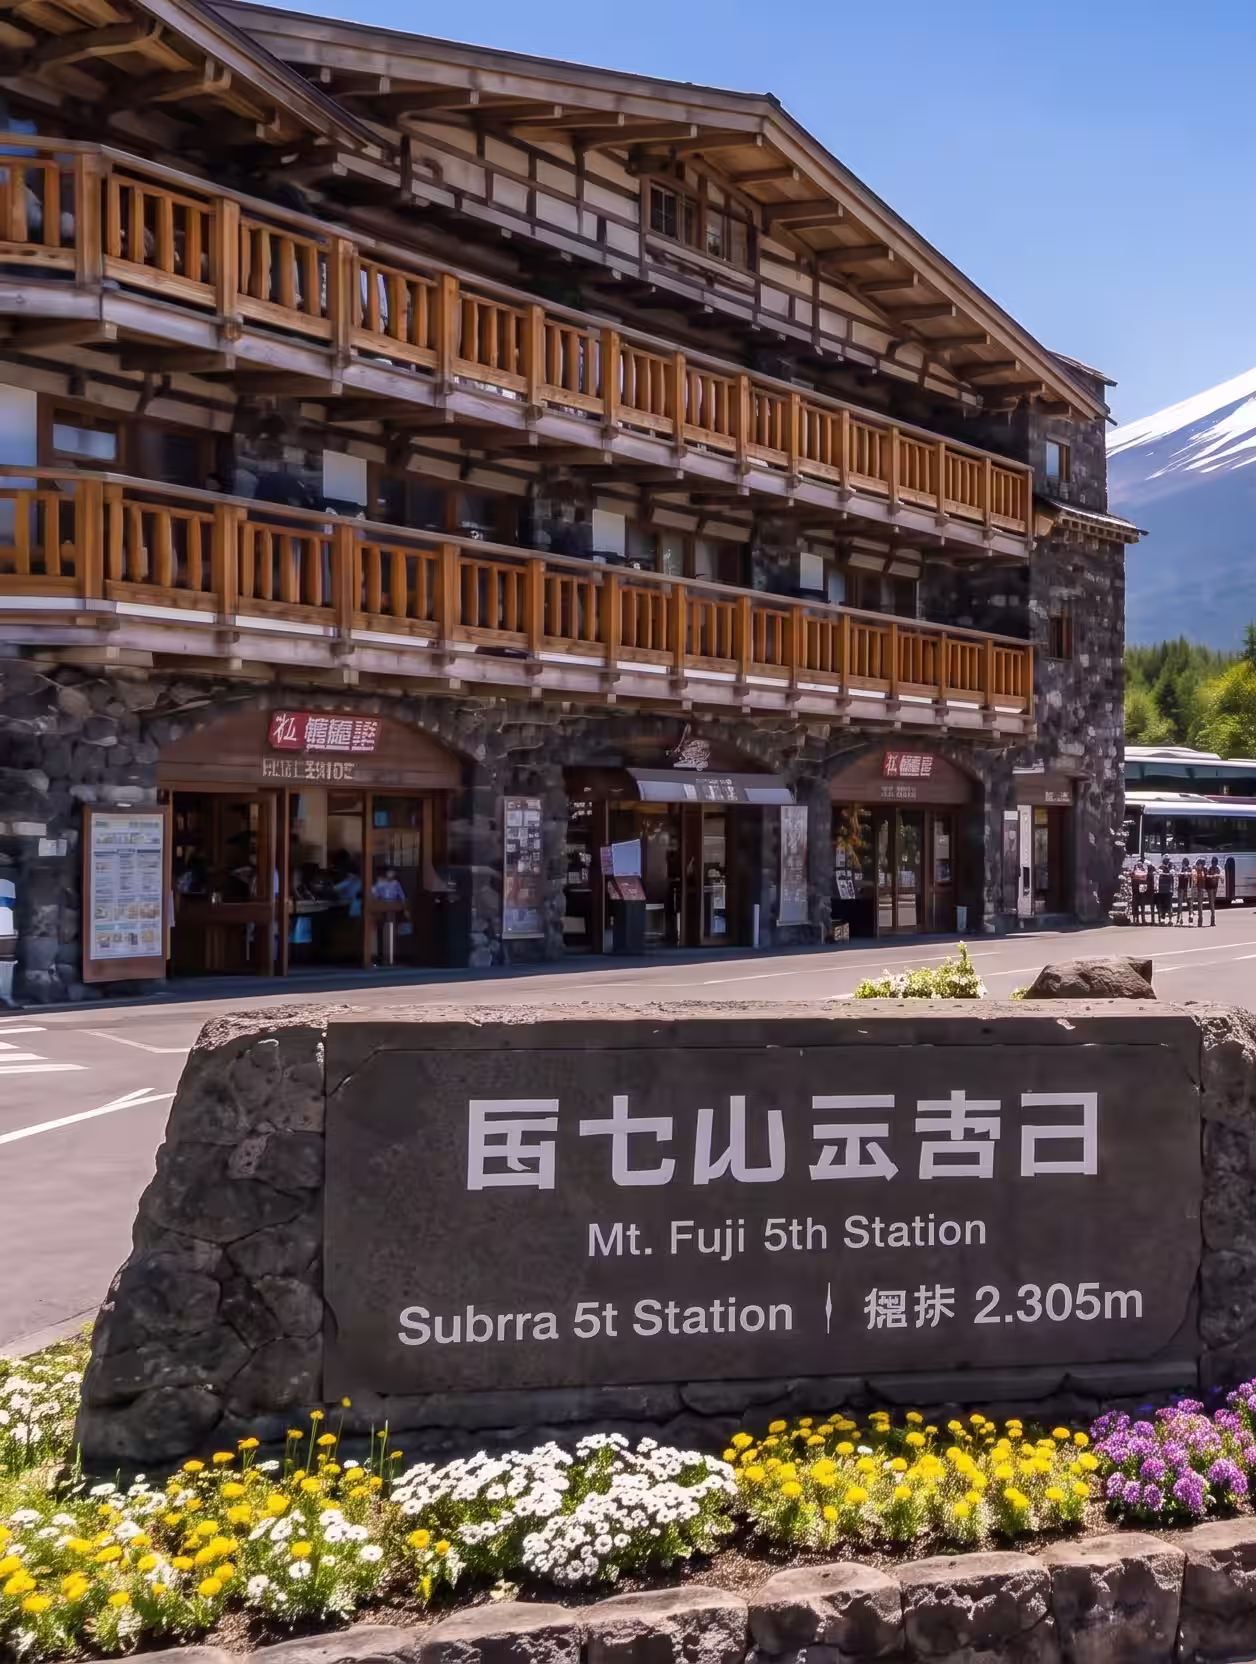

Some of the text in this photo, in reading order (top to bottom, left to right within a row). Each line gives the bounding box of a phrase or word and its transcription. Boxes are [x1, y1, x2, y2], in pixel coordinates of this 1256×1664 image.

[588, 1213, 986, 1261] Mt. Fuji 5th Station
[397, 1304, 559, 1346] Subrra
[573, 1301, 618, 1339] 5t
[632, 1296, 793, 1337] Station
[973, 1282, 1143, 1324] 2.305m
